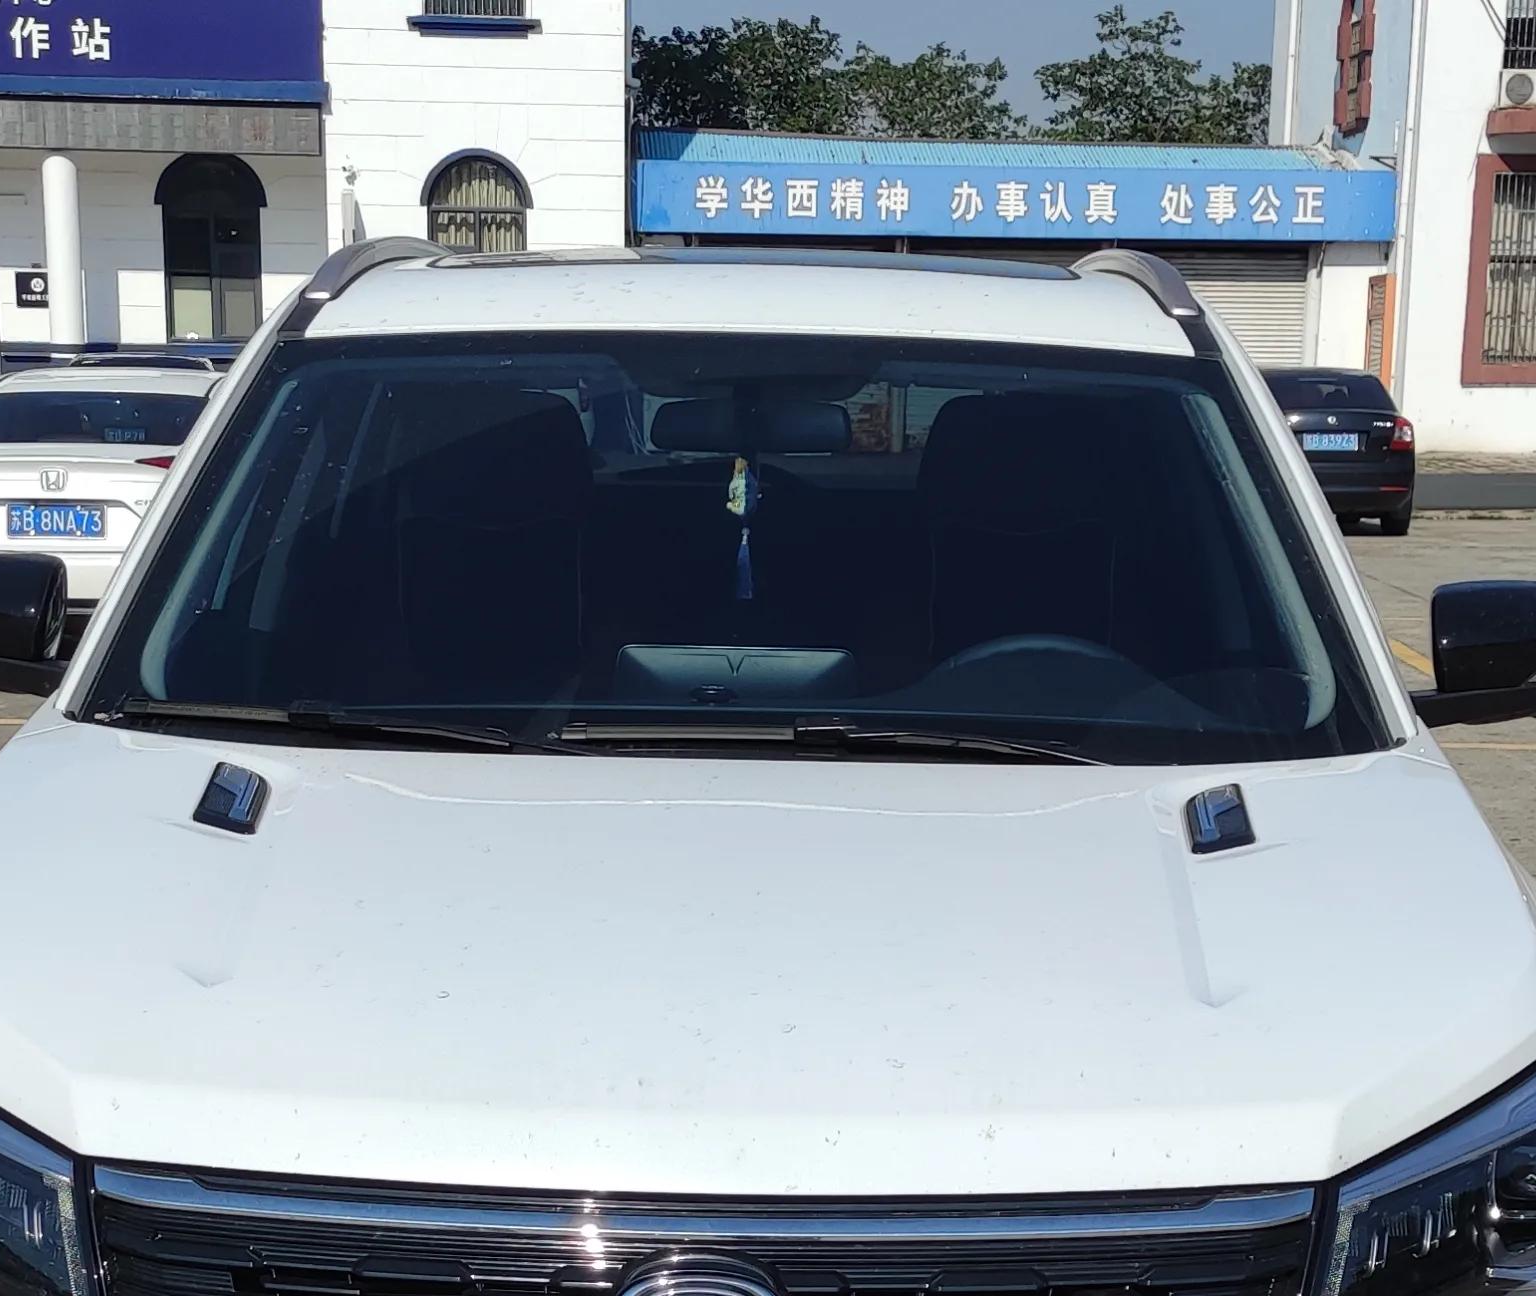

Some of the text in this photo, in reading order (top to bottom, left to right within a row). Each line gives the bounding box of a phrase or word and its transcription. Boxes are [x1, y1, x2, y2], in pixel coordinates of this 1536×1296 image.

[695, 175, 1325, 225] 学华西精神 办事认真 处事公正
